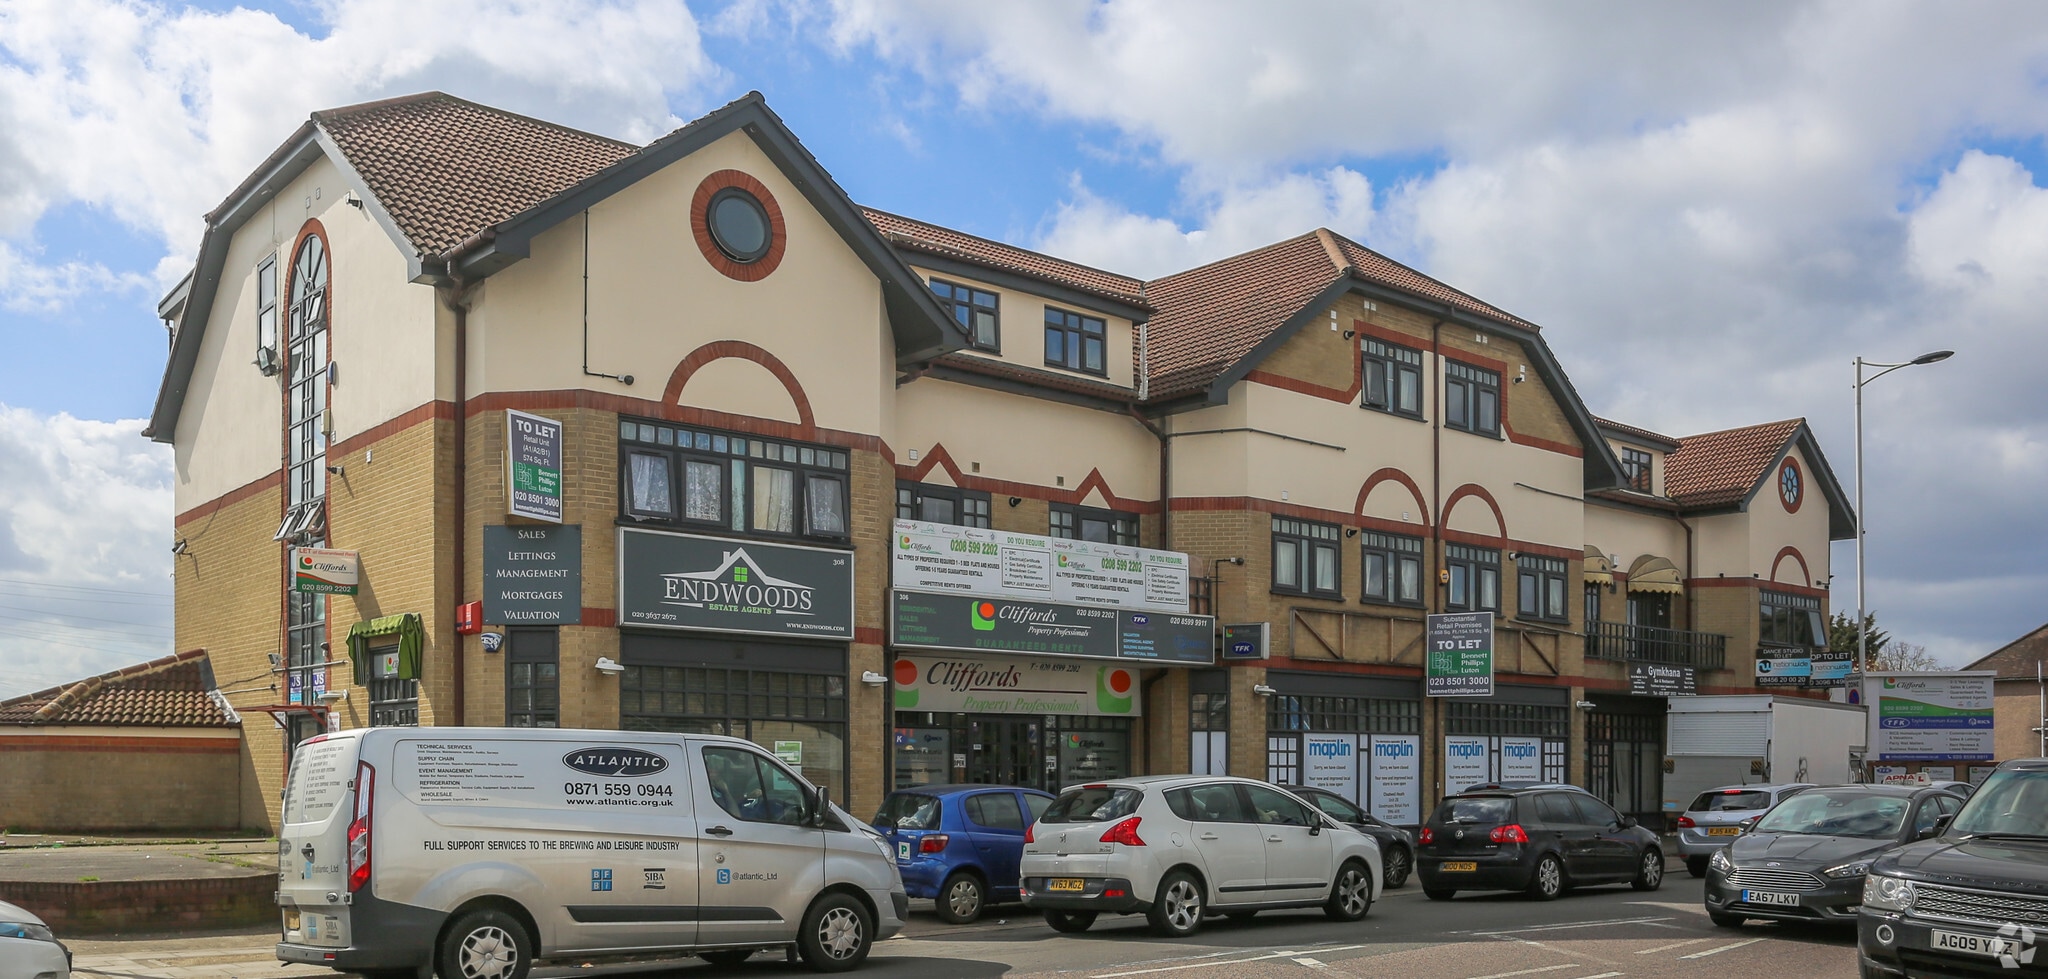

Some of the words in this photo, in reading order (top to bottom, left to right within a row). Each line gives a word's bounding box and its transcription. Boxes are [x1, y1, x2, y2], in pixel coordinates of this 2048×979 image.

[516, 420, 532, 433] TO
[536, 424, 556, 438] LET
[523, 434, 538, 444] Retail
[539, 438, 550, 446] Unit
[523, 454, 533, 462] 574
[538, 469, 558, 478] Bennett
[538, 476, 556, 486] Phillips
[539, 485, 552, 494] Luton
[514, 490, 527, 500] 020
[528, 493, 543, 504] 8501
[544, 497, 559, 508] 3000
[518, 530, 546, 539] SALES
[950, 539, 966, 552] 0208
[968, 541, 980, 553] 599
[982, 543, 998, 555] 2202
[508, 551, 556, 561] LETTINGS
[314, 563, 347, 571] Cliffords
[1102, 557, 1115, 570] 0208
[1117, 559, 1128, 571] 599
[1128, 561, 1142, 572] 2202
[496, 569, 568, 578] MANAGEMENT
[501, 591, 563, 600] MORTGAGES
[664, 578, 812, 610] ENDWOODS
[504, 610, 560, 620] VALUATION
[708, 604, 739, 612] ESTATE
[741, 605, 772, 615] AGENTS
[999, 605, 1058, 624] Cliffords
[645, 612, 661, 620] 3637
[1028, 626, 1053, 636] Property
[1053, 628, 1089, 637] Professionals
[976, 638, 1047, 651] GUARANTEED
[1051, 643, 1084, 652] RENTS
[1437, 640, 1454, 650] TO
[1458, 639, 1482, 649] LET
[1066, 664, 1081, 673] 2202
[1648, 665, 1680, 678] Gymkhana
[314, 673, 324, 685] JS
[926, 661, 1021, 692] Cliffords
[963, 696, 1012, 712] Property
[1014, 697, 1081, 714] Professionals
[1309, 739, 1350, 760] maplin
[1375, 740, 1413, 760] maplin
[1449, 741, 1483, 759] maplin
[1504, 742, 1536, 760] maplin
[574, 755, 661, 767] ATLANTIC
[564, 782, 598, 795] 0871
[604, 784, 631, 796] 559
[637, 784, 673, 796] 0944
[566, 798, 673, 808] www.atlantic.org.uk
[424, 841, 444, 850] FULL
[447, 841, 484, 850] SUPPORT
[488, 841, 526, 850] SERVICES
[529, 841, 539, 850] TO
[542, 841, 556, 850] THE
[560, 841, 594, 850] BREWING
[596, 841, 612, 850] AND
[614, 841, 644, 850] LEISURE
[646, 841, 680, 850] INDUSTRY
[901, 845, 907, 854] P
[645, 873, 664, 881] SIBA
[732, 872, 777, 881] @atlantic_Ltd
[1749, 892, 1774, 902] EA67
[1777, 894, 1797, 904] LKV
[1940, 934, 1978, 950] AG09
